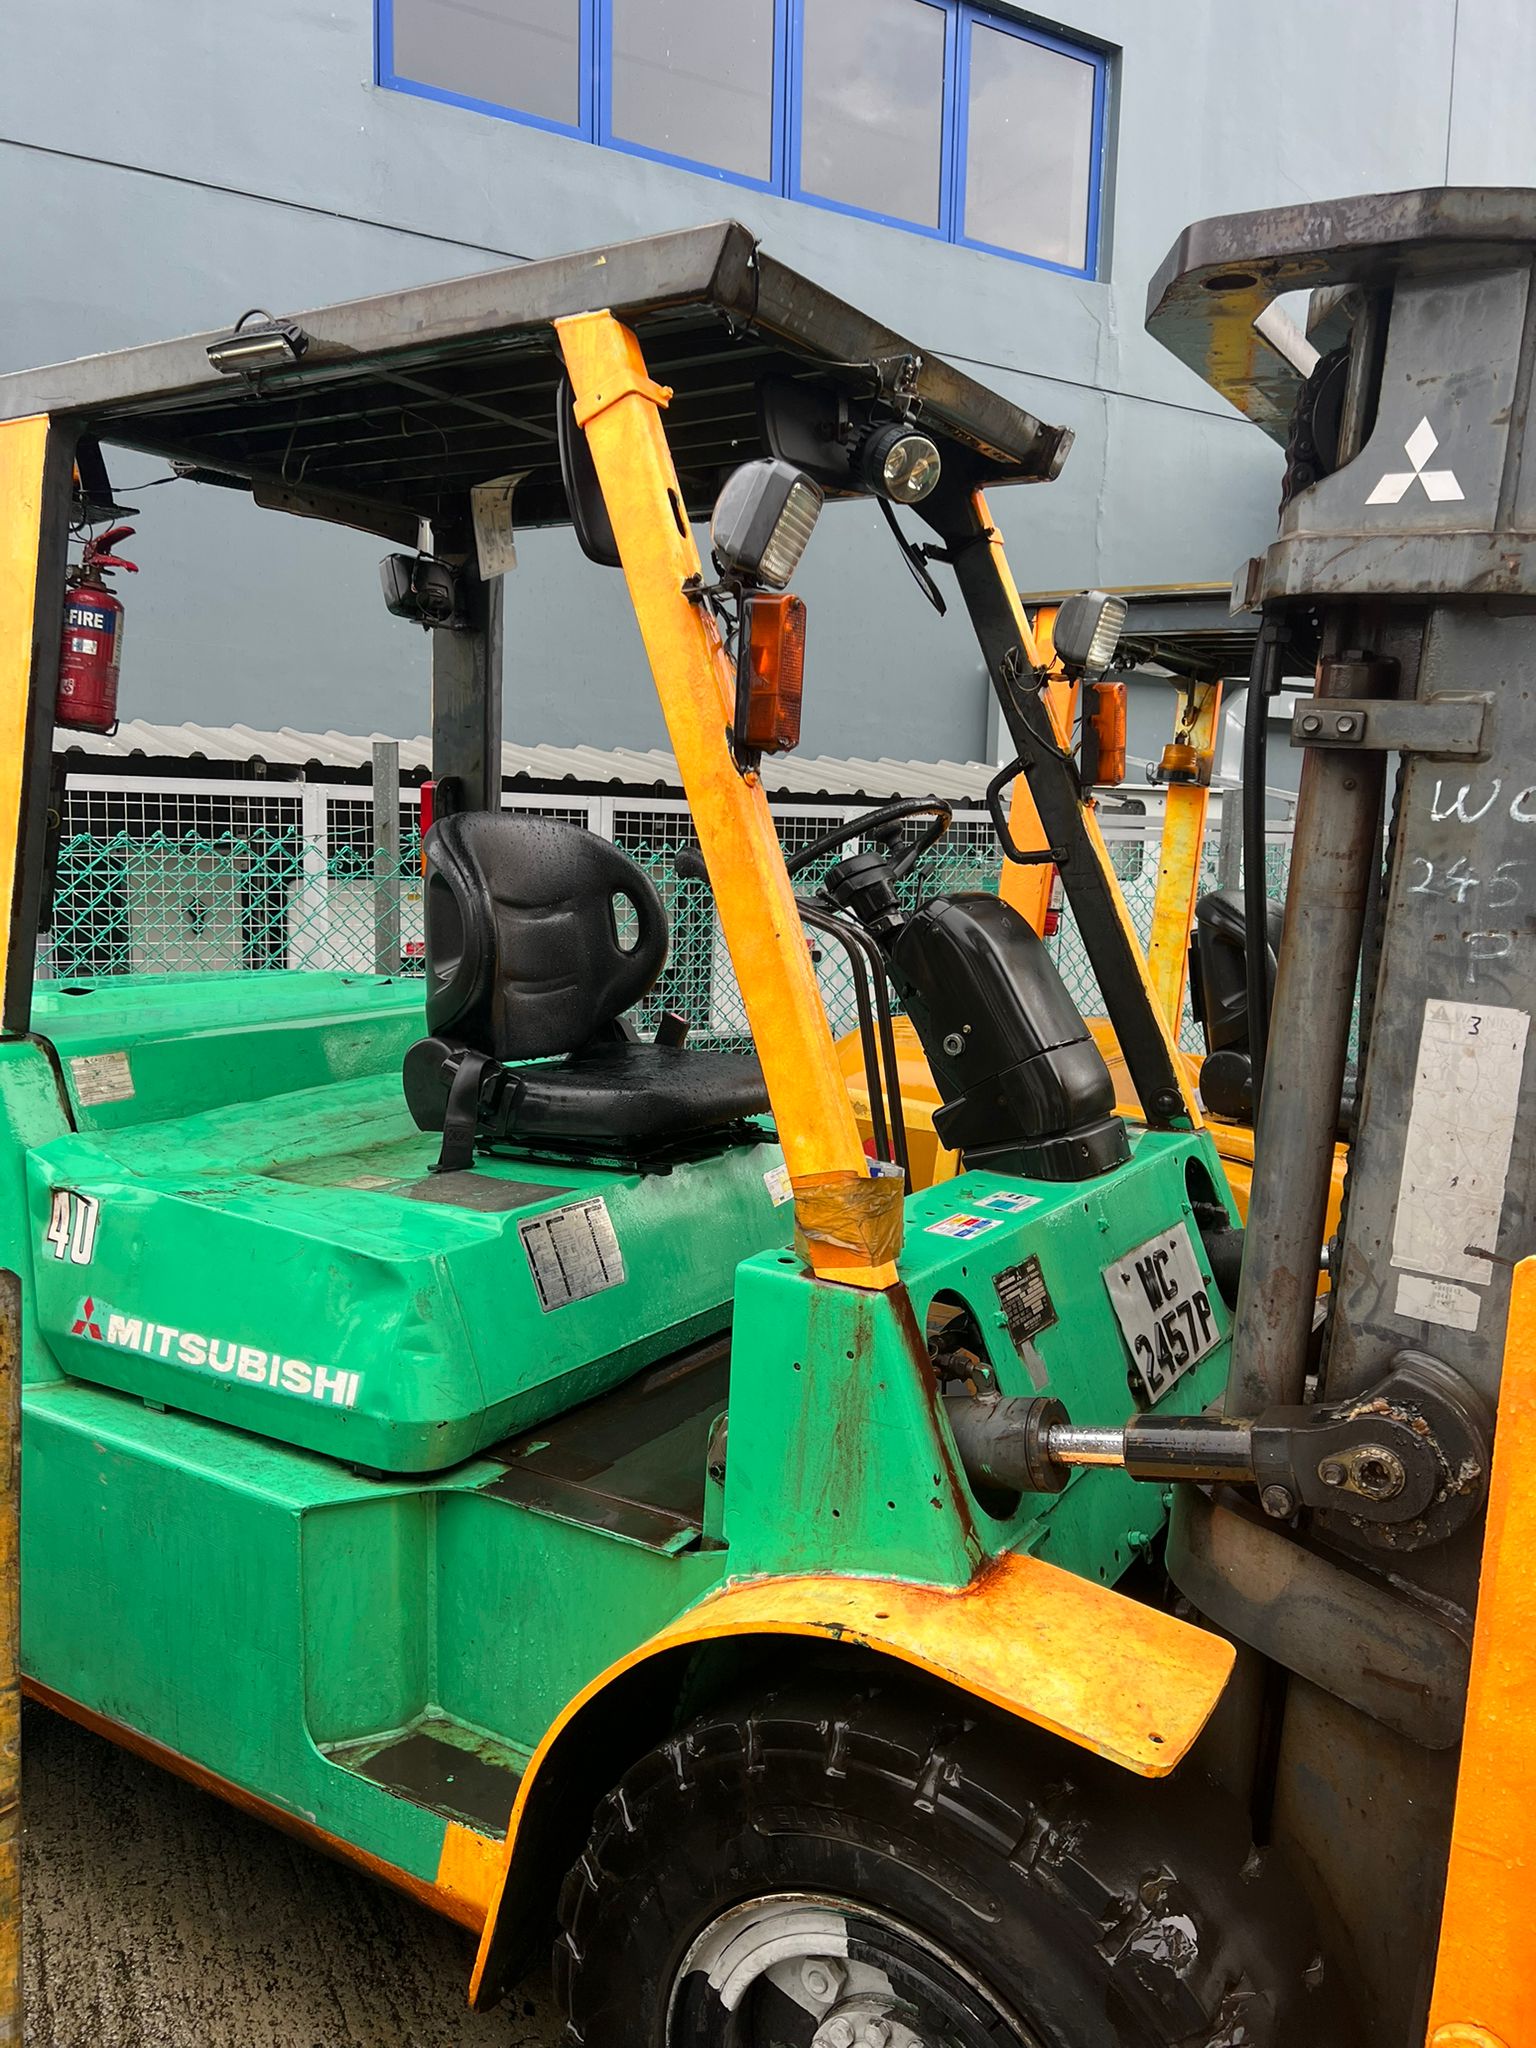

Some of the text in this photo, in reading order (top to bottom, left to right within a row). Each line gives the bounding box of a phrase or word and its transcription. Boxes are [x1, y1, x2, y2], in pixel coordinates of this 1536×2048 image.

[69, 609, 104, 629] FIRE
[1464, 931, 1513, 984] P
[1468, 1015, 1482, 1035] 3
[47, 1188, 99, 1265] 40
[106, 1313, 360, 1408] MITSUBISHI
[1134, 1290, 1212, 1393] 2457P
